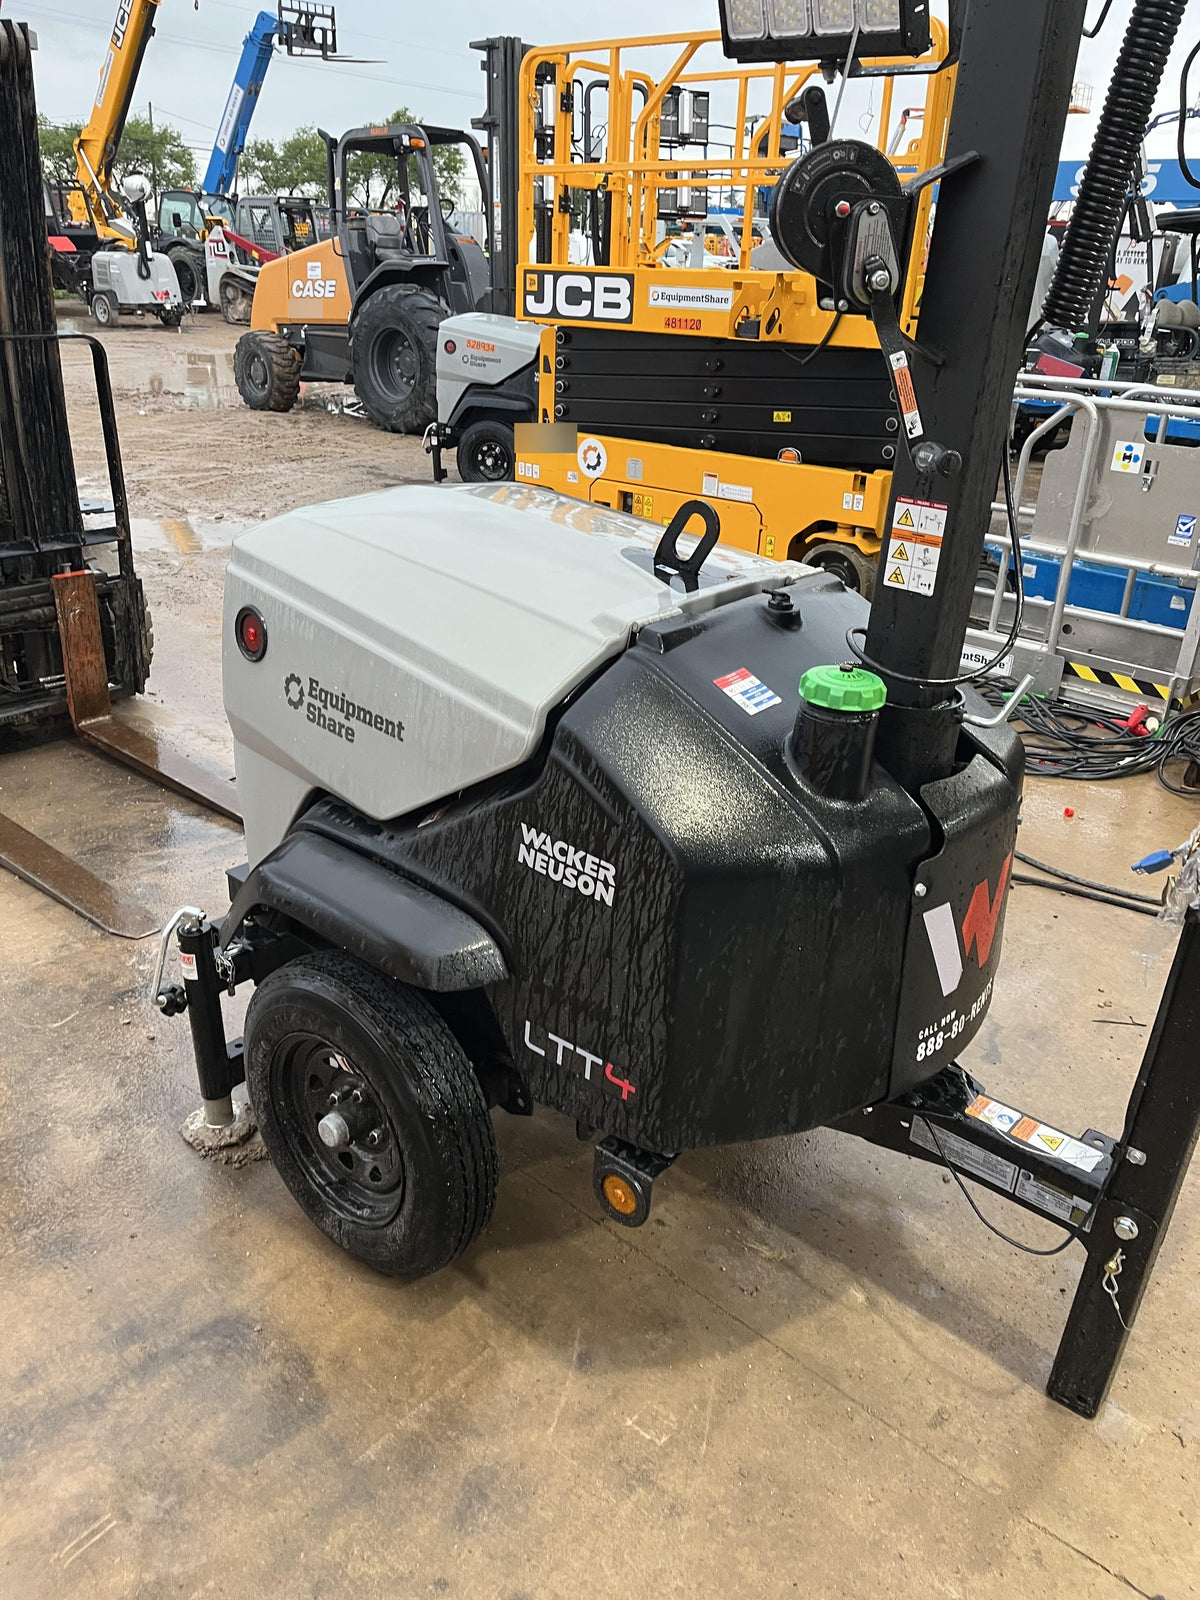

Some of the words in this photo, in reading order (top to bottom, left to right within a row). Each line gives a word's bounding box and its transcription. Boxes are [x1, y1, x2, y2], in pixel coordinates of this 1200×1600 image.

[292, 280, 336, 298] CASE
[525, 274, 631, 319] JCB
[660, 291, 729, 304] EquipmentShare
[664, 318, 702, 330] 481120
[466, 340, 495, 353] 528934
[470, 354, 501, 363] Equipment
[470, 359, 487, 368] Share
[306, 702, 355, 743] Share
[308, 677, 405, 742] Equipment
[521, 822, 616, 887] WACKER
[518, 843, 615, 907] NEUSON
[918, 1022, 938, 1040] CALL
[941, 1009, 956, 1027] NOW
[524, 1020, 636, 1101] LTT4
